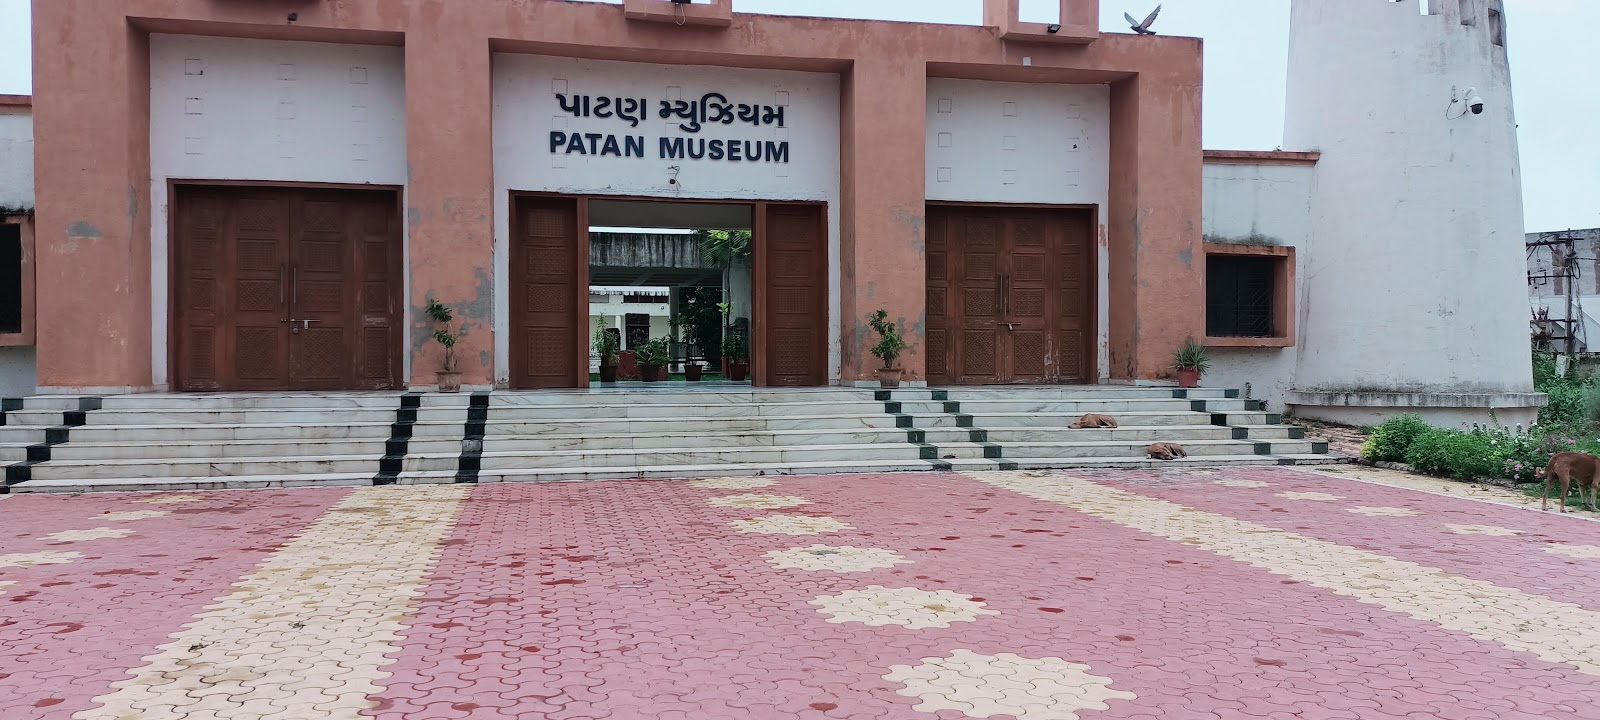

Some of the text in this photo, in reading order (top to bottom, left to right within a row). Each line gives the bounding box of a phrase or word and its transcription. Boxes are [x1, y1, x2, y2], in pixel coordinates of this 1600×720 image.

[555, 92, 785, 133] પાટણ મ્યુઝિયમ
[550, 131, 789, 163] PATAN MUSEUM
